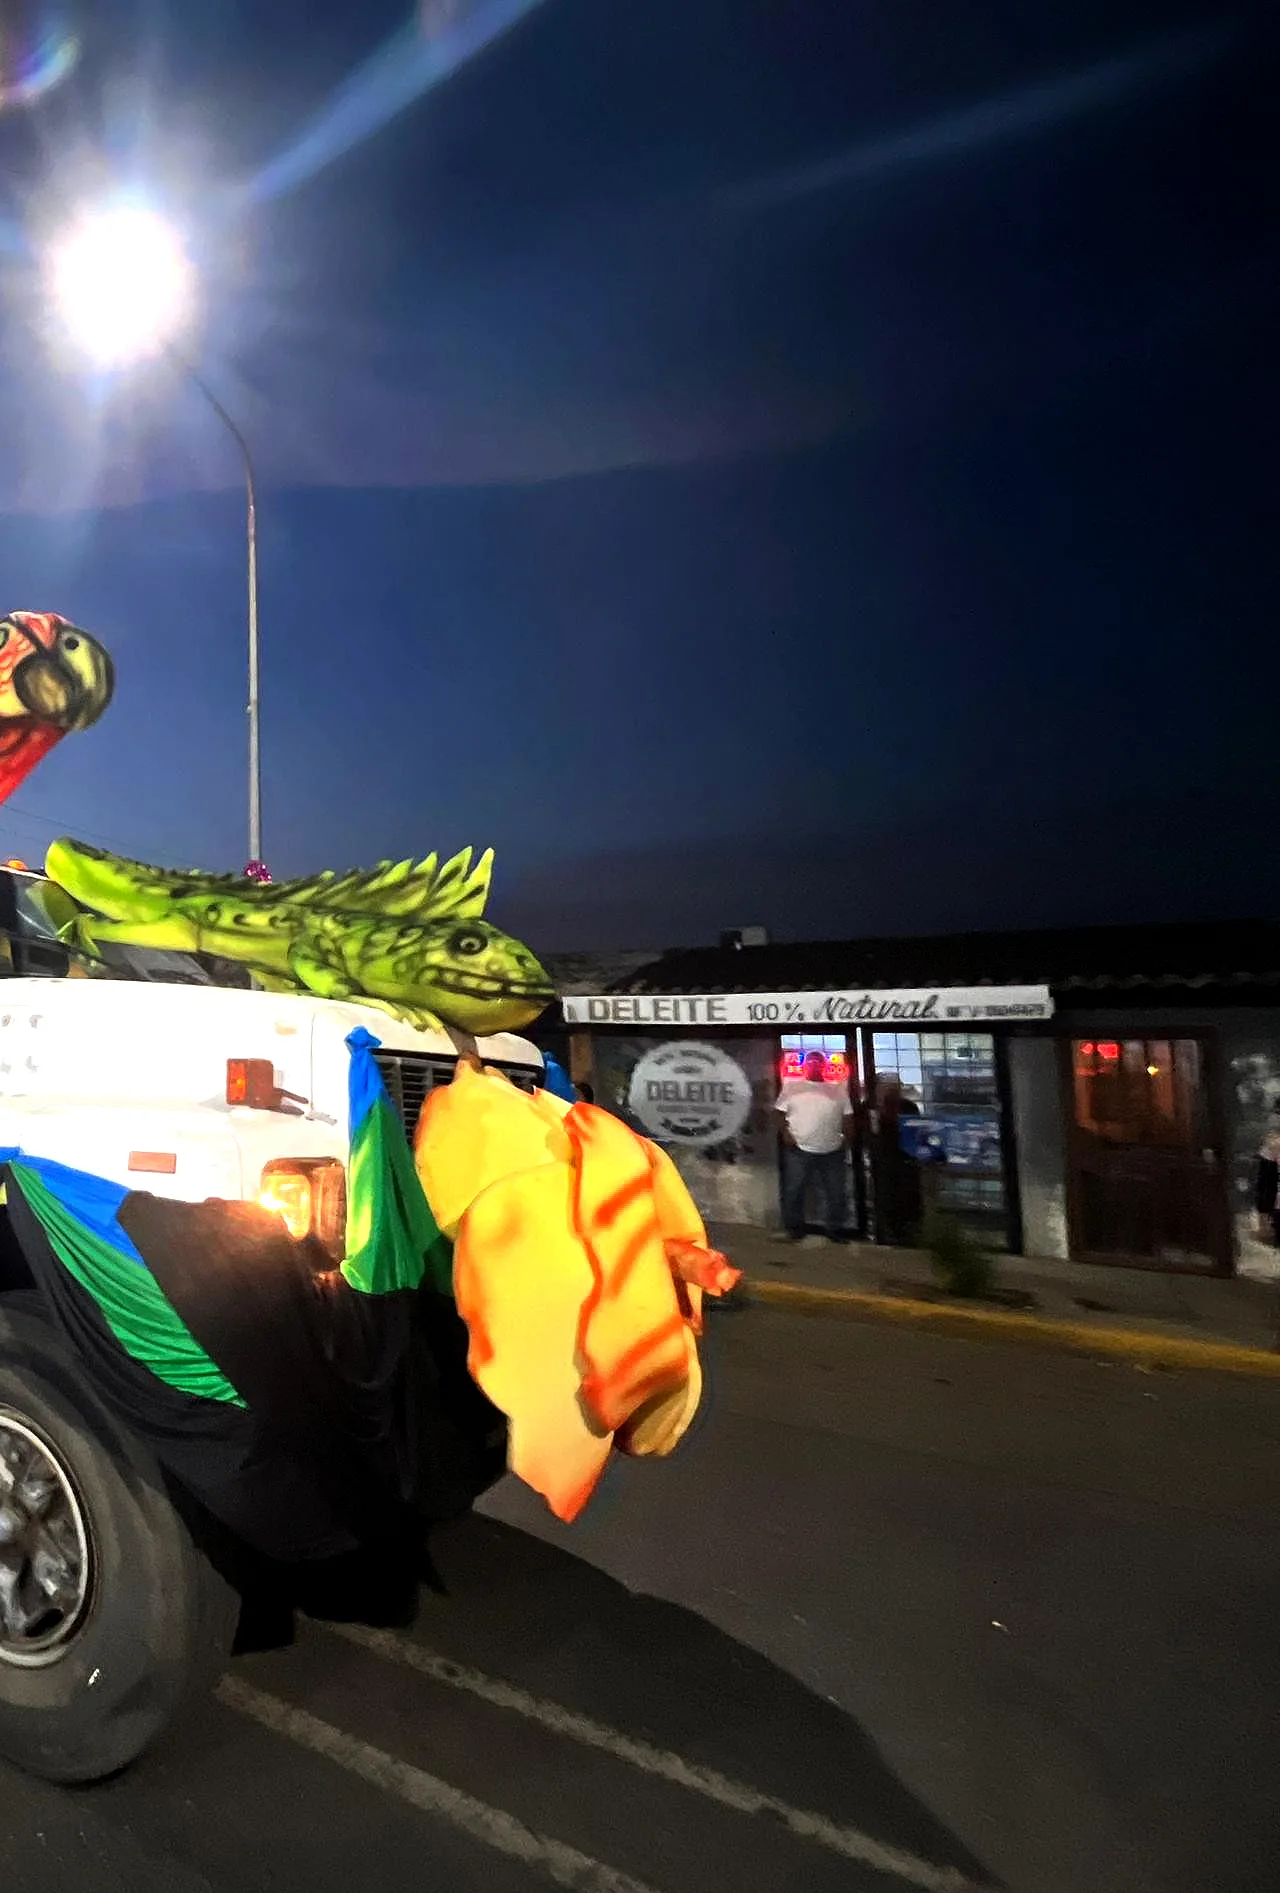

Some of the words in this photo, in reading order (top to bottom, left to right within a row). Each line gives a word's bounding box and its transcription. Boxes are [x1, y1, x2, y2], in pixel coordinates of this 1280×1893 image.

[588, 997, 727, 1022] DELEITE
[813, 994, 939, 1021] Natural
[646, 1080, 734, 1105] DELEITE
